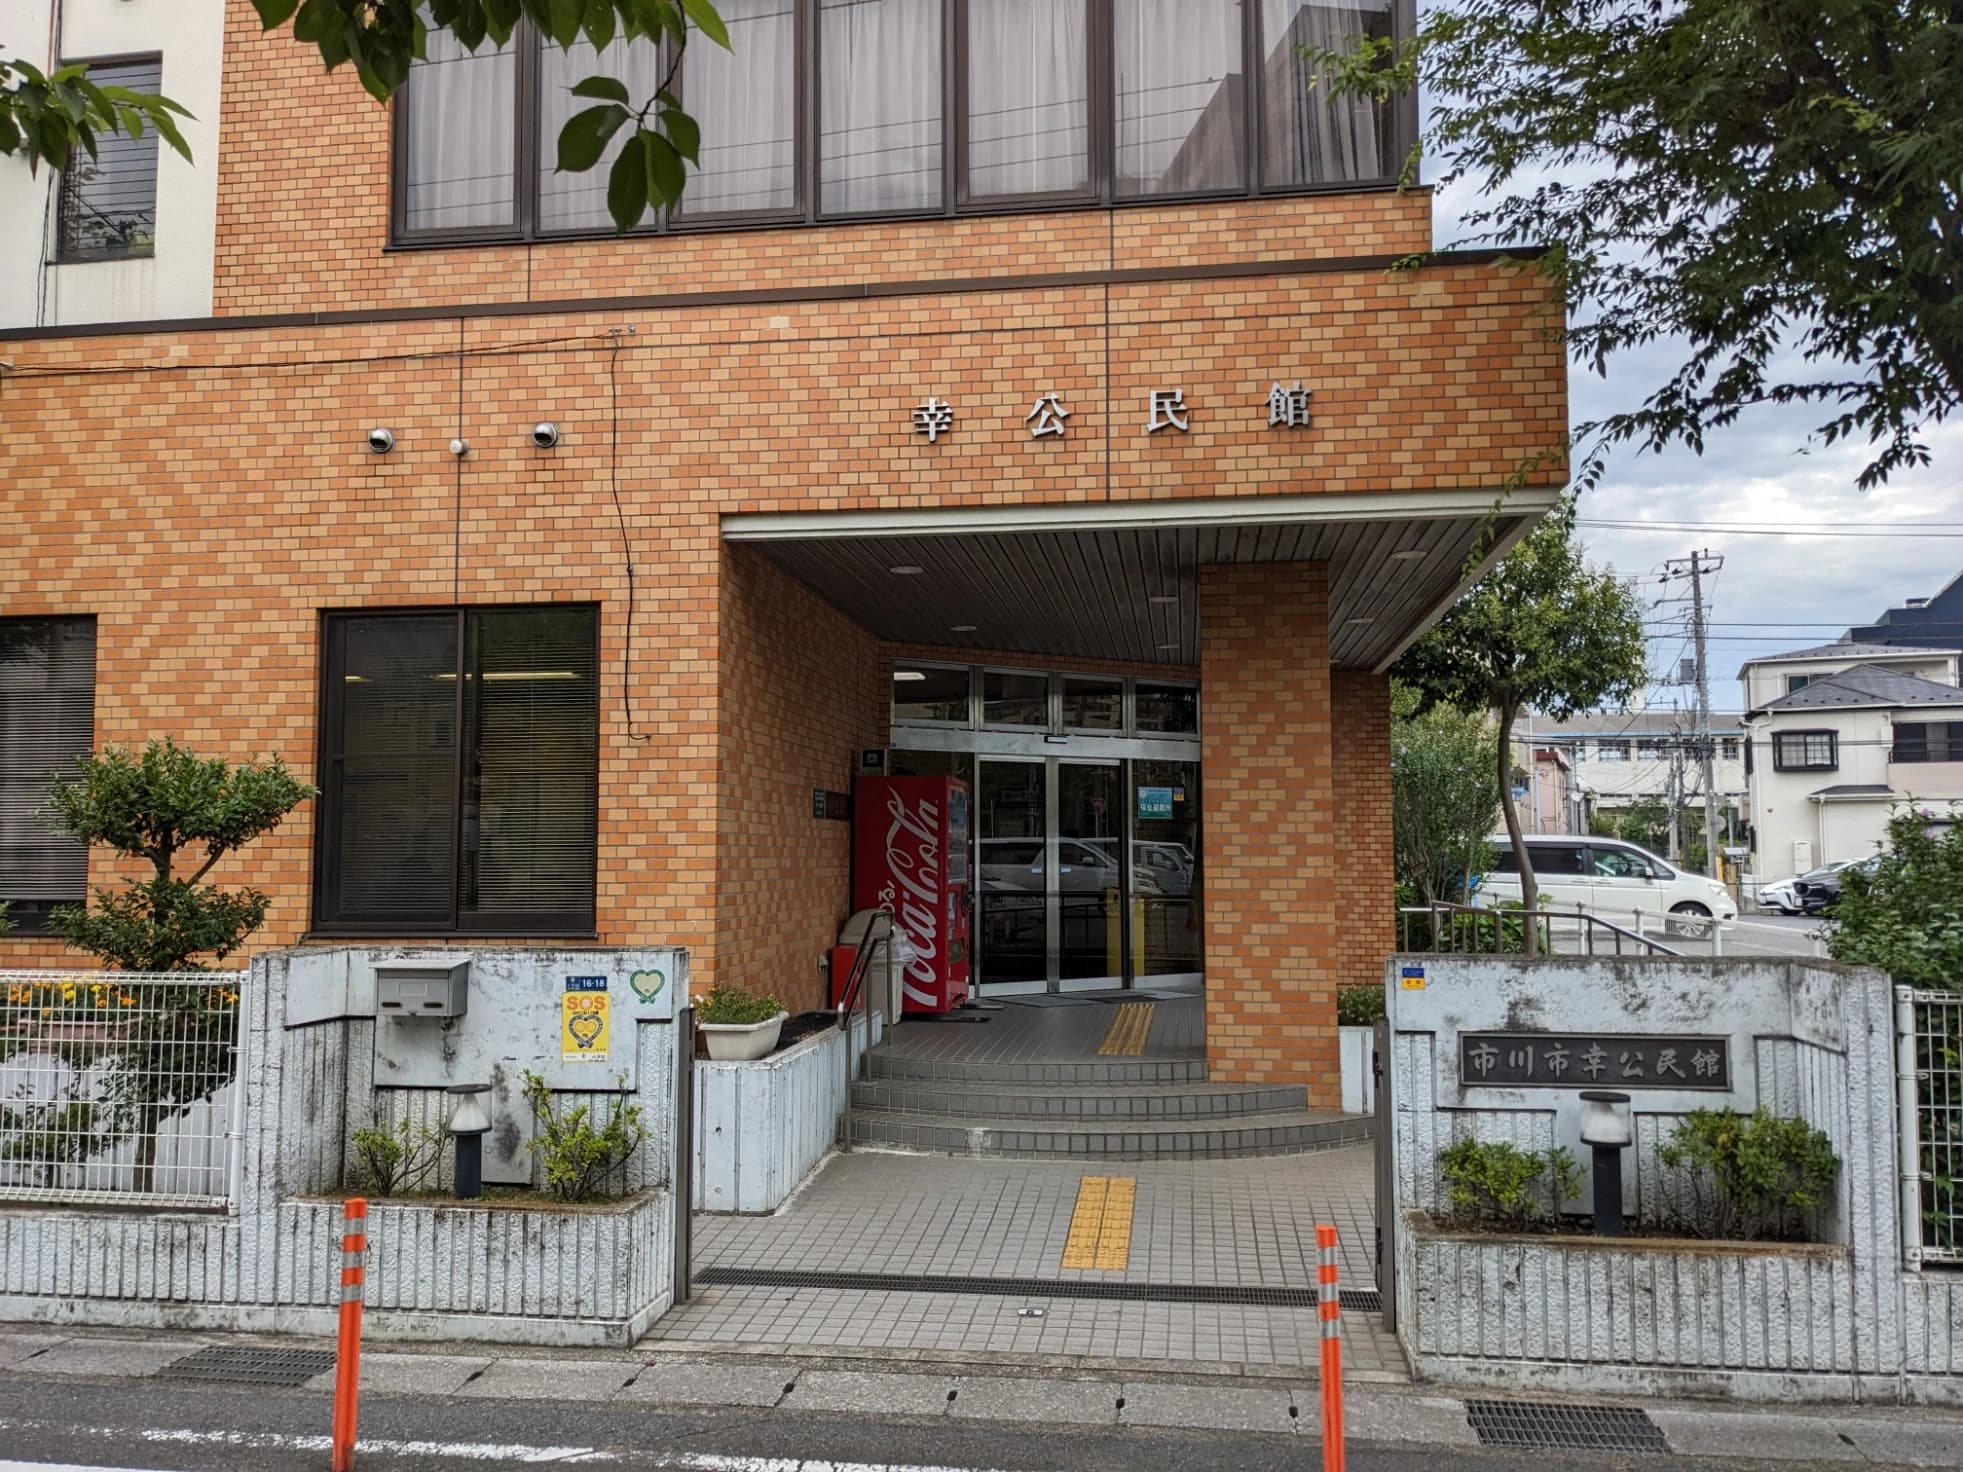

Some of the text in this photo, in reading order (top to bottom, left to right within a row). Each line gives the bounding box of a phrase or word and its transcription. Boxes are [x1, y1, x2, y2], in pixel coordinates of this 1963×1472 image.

[912, 381, 1313, 443] 幸公民館
[582, 978, 605, 988] 16-18
[566, 996, 606, 1011] SOS
[1468, 1041, 1721, 1080] 市川市幸公民館
